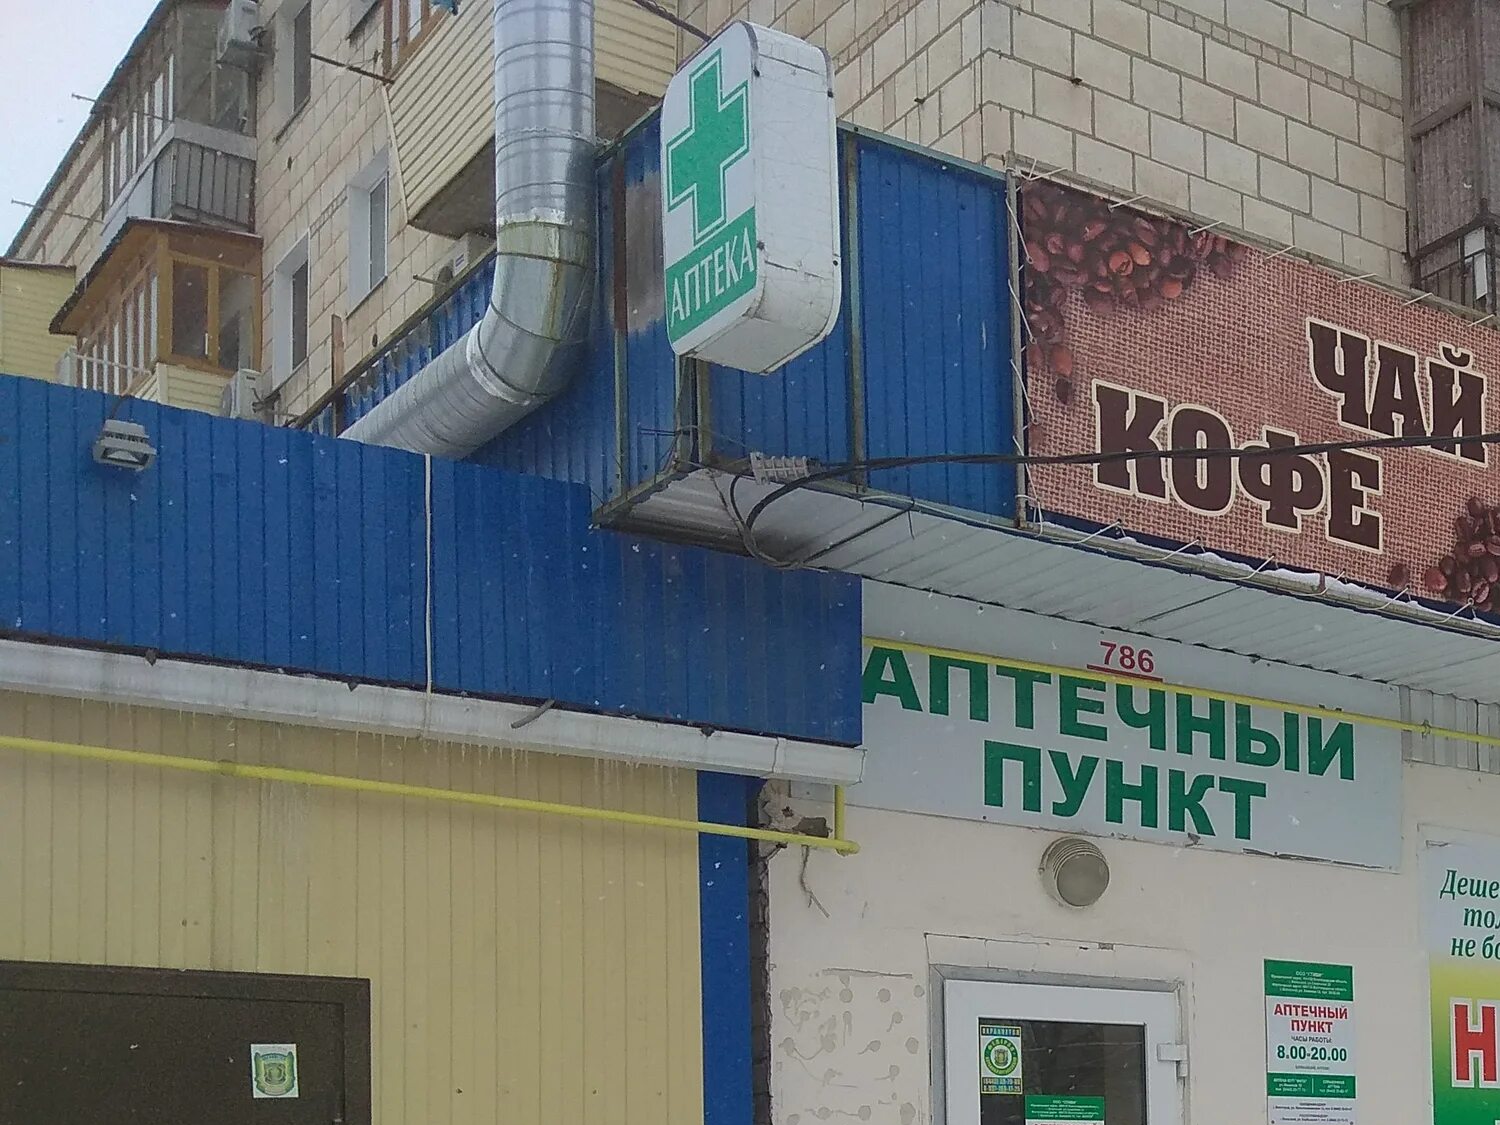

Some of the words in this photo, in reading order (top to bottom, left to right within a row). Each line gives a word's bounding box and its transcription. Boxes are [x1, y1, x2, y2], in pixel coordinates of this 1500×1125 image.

[670, 226, 755, 328] АПТЕКА
[1306, 317, 1488, 468] ЧАЙ
[1092, 379, 1384, 554] КОФЕ
[1101, 640, 1155, 674] 786
[862, 646, 1356, 782] АПТЕЧНЫЙ
[983, 739, 1267, 841] ПУНКТ
[1450, 936, 1476, 958] не
[1273, 1003, 1348, 1019] АПТЕЧНЫЙ
[1291, 1019, 1333, 1033] ПУНКТ
[1277, 1044, 1347, 1062] 8.00-20.00
